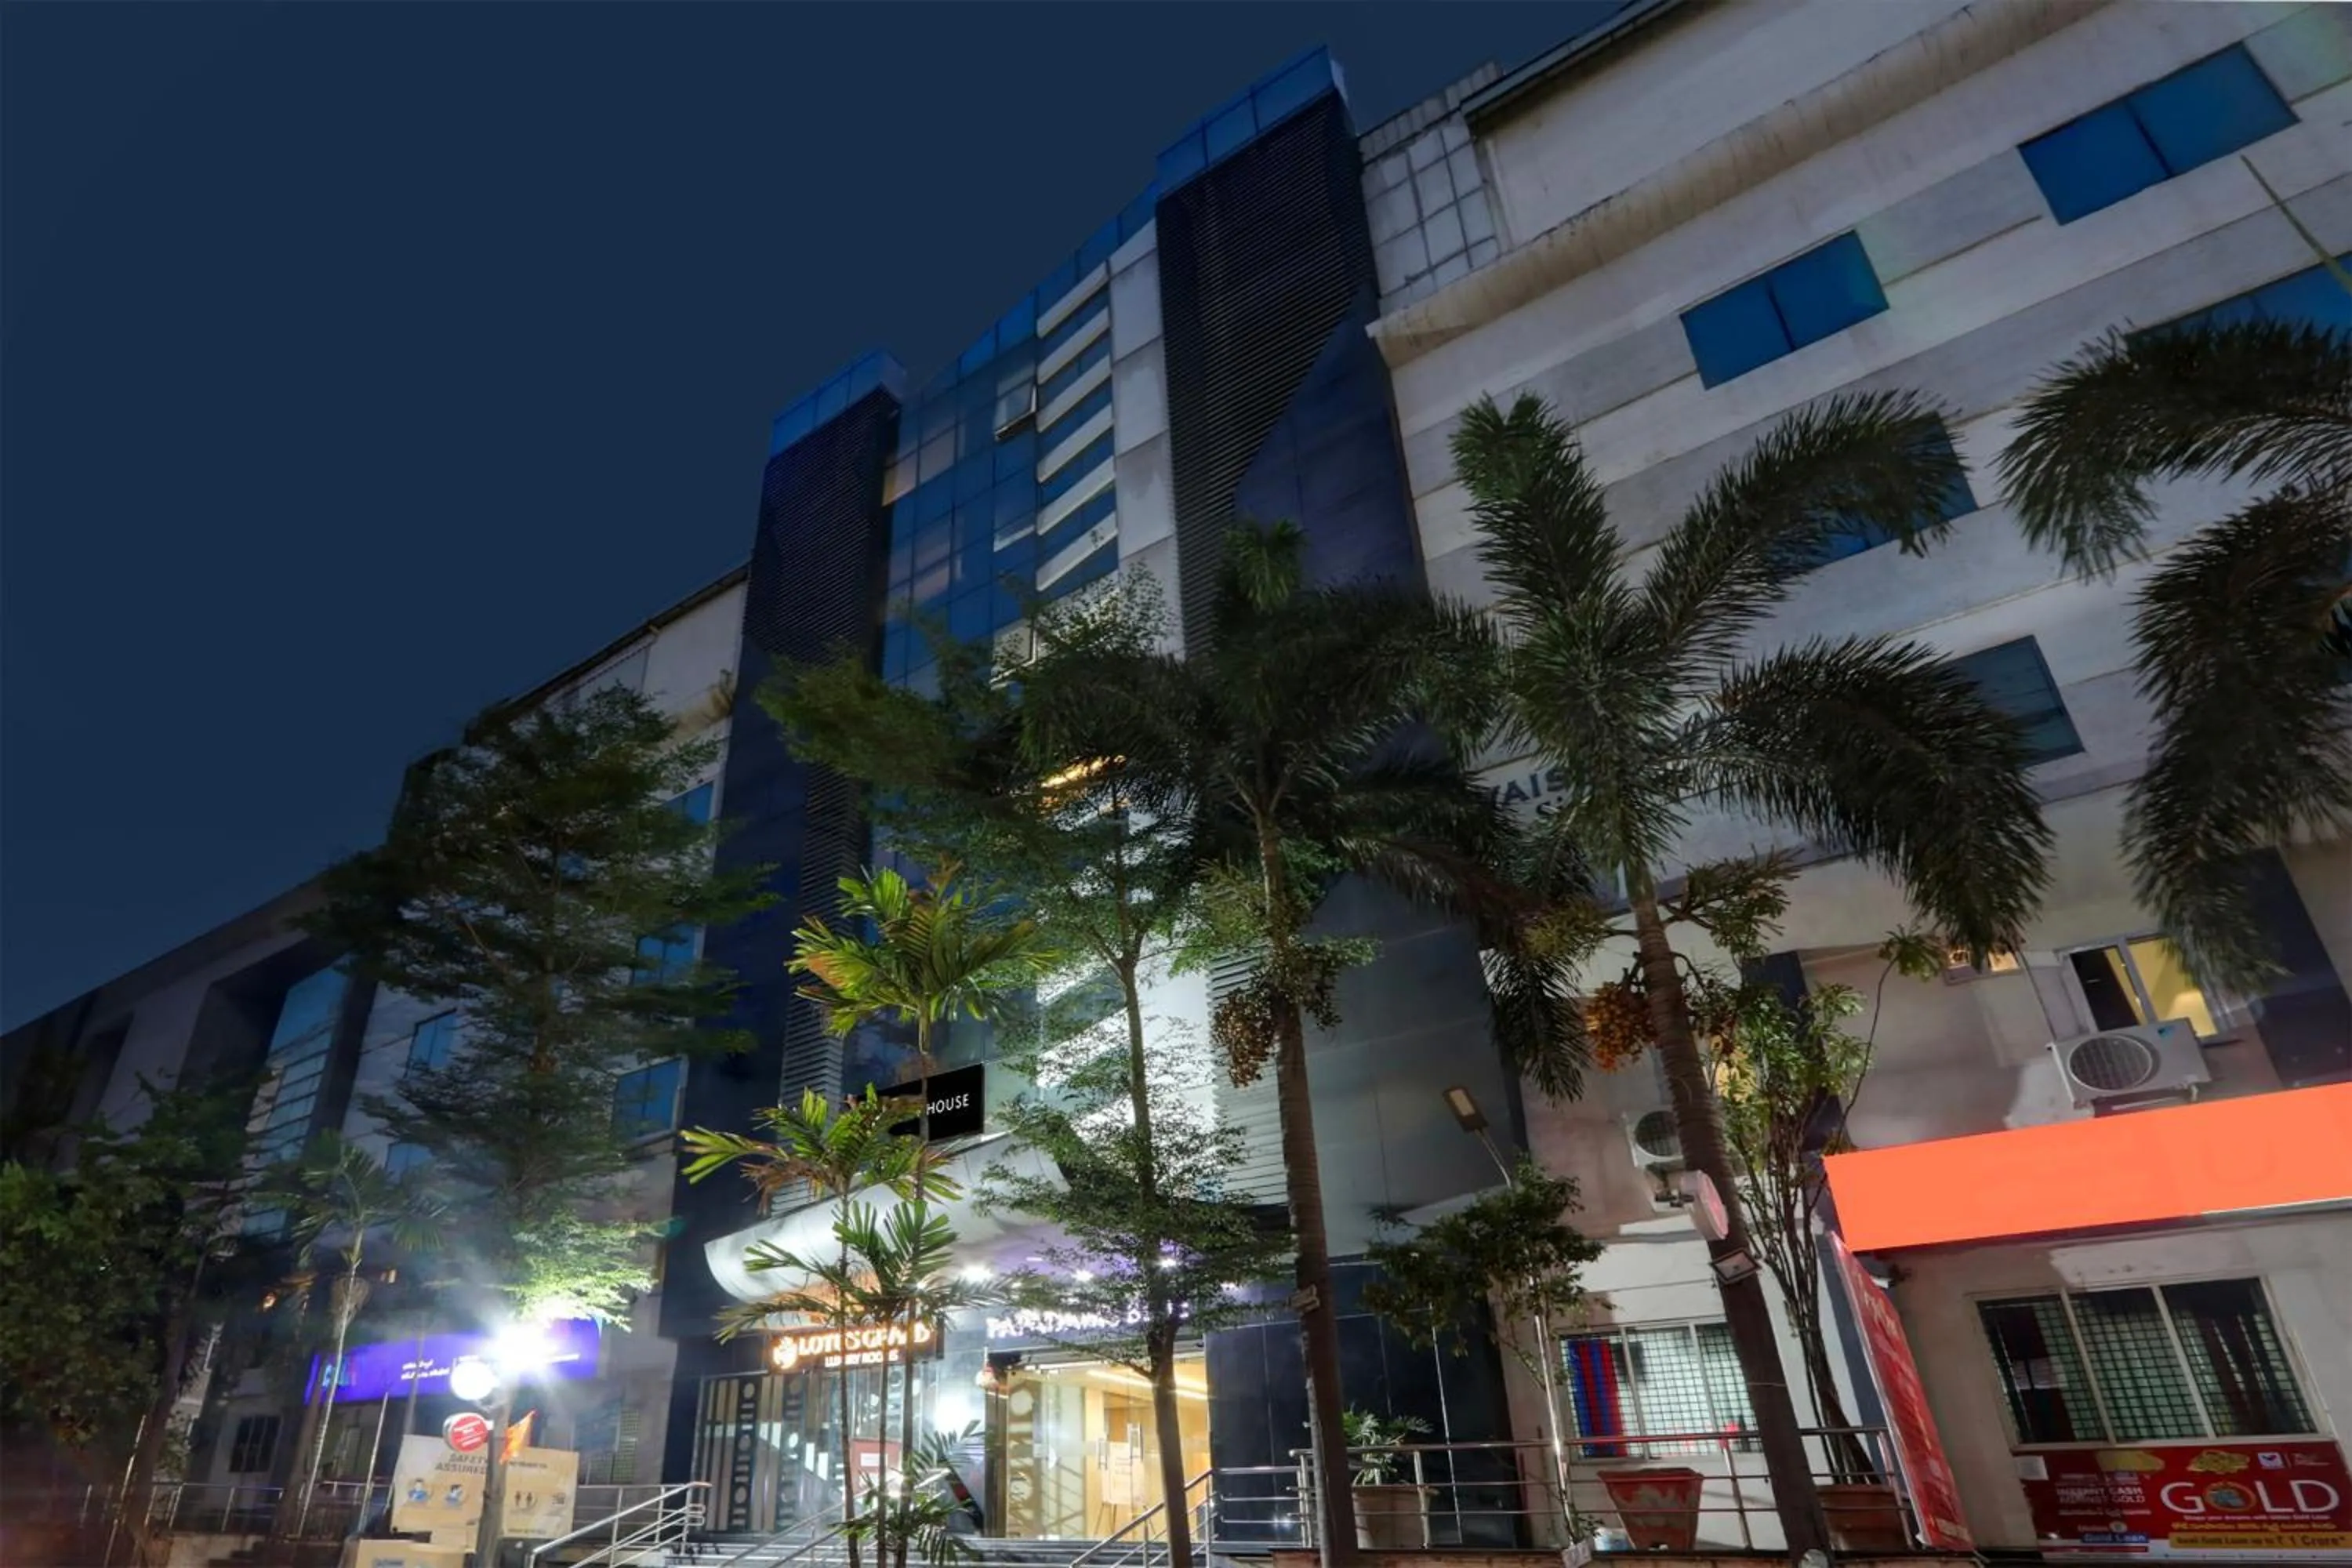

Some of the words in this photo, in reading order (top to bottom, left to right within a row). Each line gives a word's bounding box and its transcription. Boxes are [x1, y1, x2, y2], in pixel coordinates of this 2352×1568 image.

[926, 1094, 969, 1116] HOUSE
[862, 1349, 899, 1363] ROOS
[2160, 1479, 2339, 1514] GOLD
